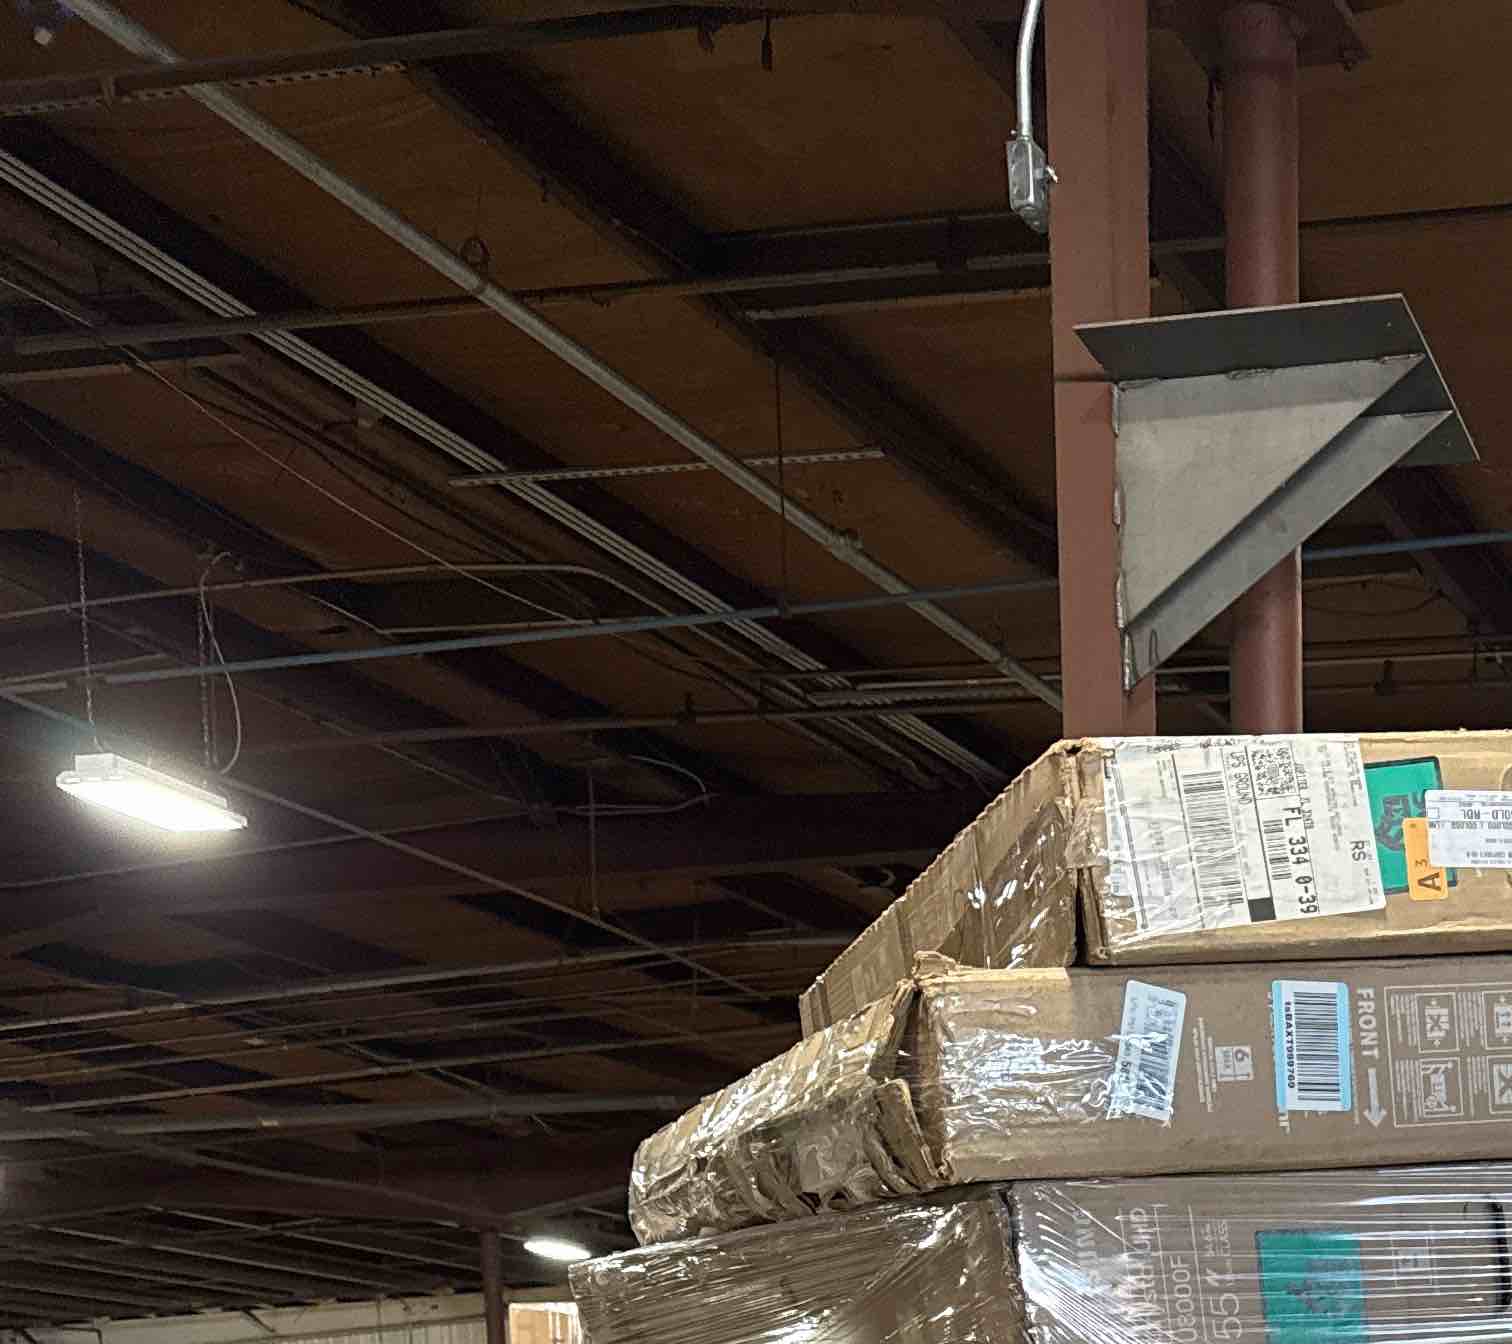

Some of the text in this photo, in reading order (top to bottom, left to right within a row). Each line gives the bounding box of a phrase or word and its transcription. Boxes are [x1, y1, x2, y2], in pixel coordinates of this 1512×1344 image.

[1283, 807, 1318, 914] FL 334 0-39
[1351, 840, 1367, 862] RS
[1416, 872, 1441, 893] A
[1356, 988, 1380, 1060] FRONT
